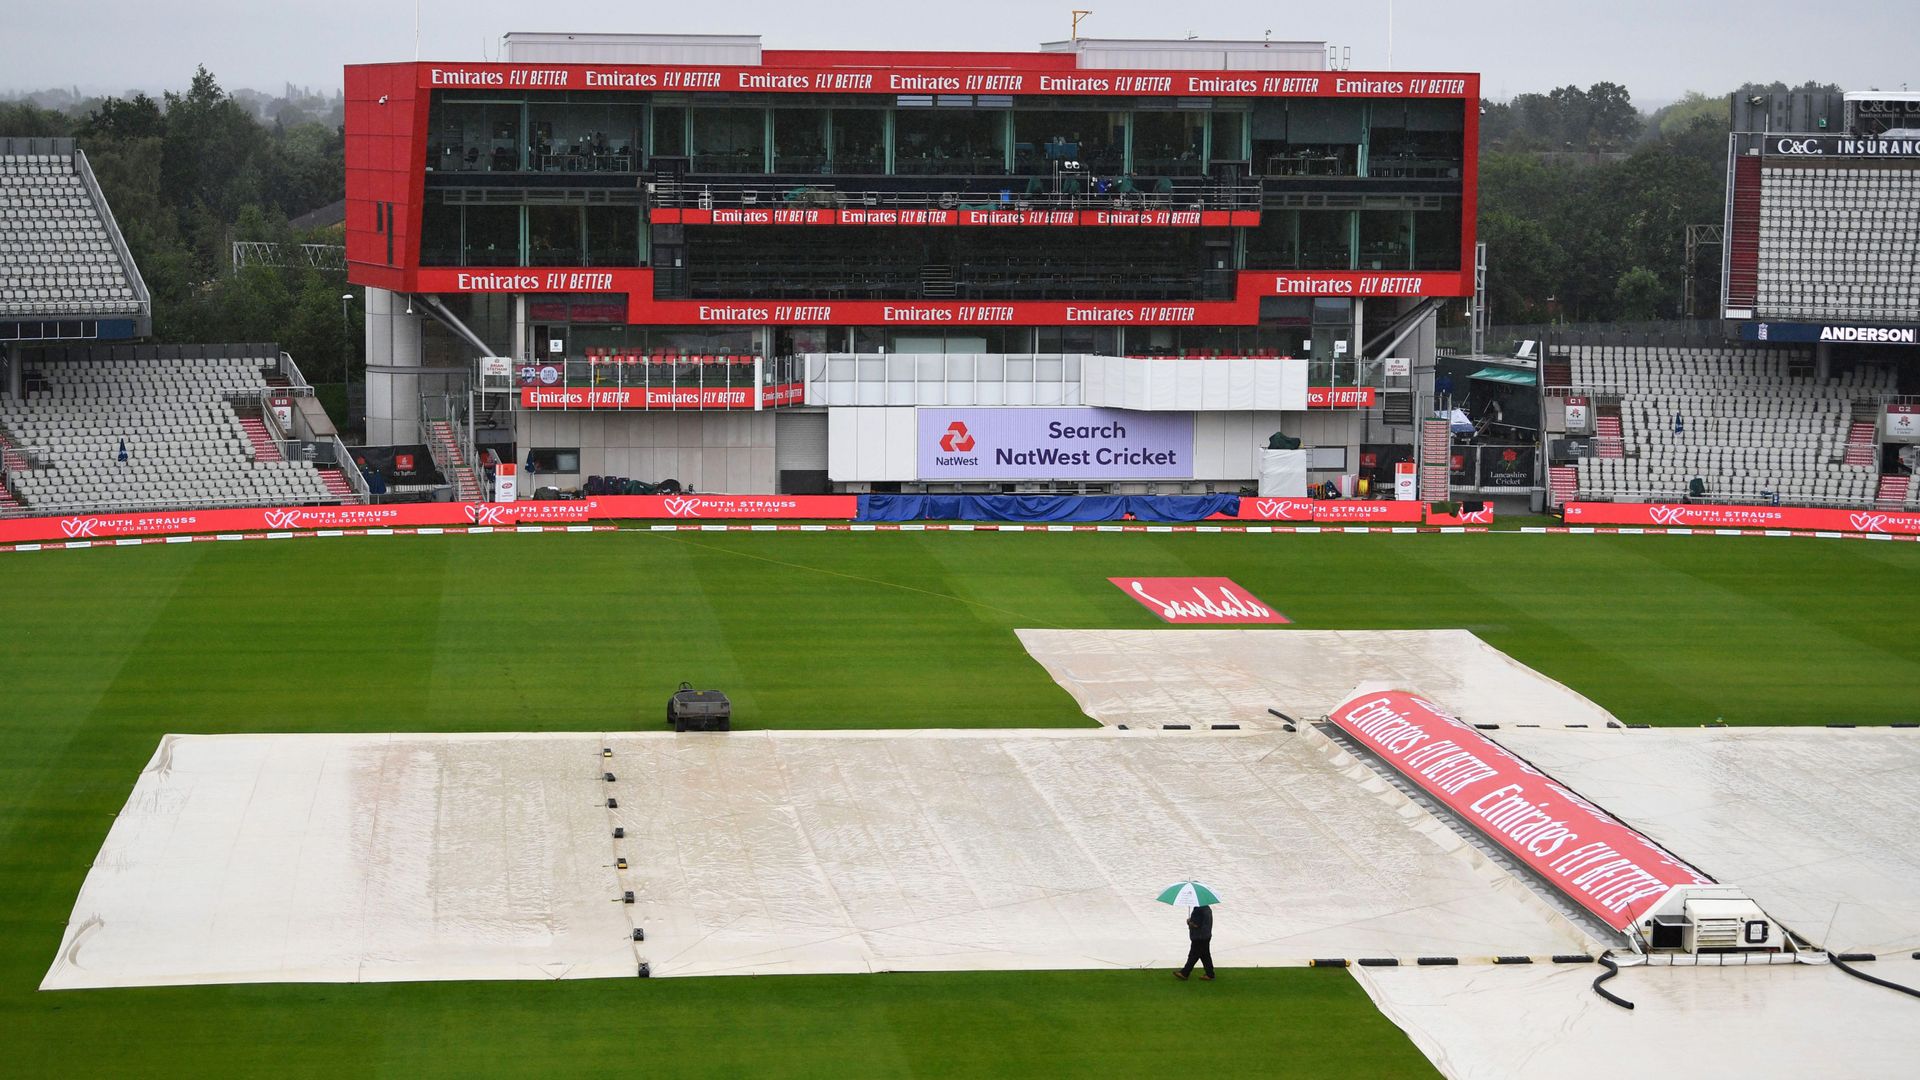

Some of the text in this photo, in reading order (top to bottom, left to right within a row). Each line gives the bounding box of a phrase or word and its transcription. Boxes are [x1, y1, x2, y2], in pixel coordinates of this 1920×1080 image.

[431, 69, 568, 86] Emirates FLY BETTER
[585, 71, 721, 87] Emirates FLY BETTER
[738, 72, 873, 89] Emirates FLY BETTER
[889, 74, 1023, 91] Emirates FLY BETTER
[1039, 76, 1172, 92] Emirates FLY BETTER
[1188, 77, 1319, 93] Emirates FLY BETTER
[1335, 79, 1465, 94] Emirates FLY BETTER
[1778, 138, 1823, 154] C&C.
[713, 210, 768, 222] Emirates
[774, 211, 788, 221] FLY
[842, 210, 947, 223] Emirates FLY BETTER
[971, 211, 1025, 223] Emirates
[1029, 212, 1044, 223] FLY
[1098, 211, 1201, 224] Emirates FLY BETTER
[457, 273, 613, 290] Emirates FLY BETTER
[1276, 276, 1422, 294] Emirates FLY BETTER
[699, 305, 831, 321] Emirates FLY BETTER
[883, 306, 1014, 321] Emirates FLY BETTER
[1066, 306, 1195, 321] Emirates FLY BETTER
[1820, 327, 1914, 342] ANDERSON
[530, 391, 630, 404] Emirates FLY BETTER
[648, 392, 745, 404] Emirates FLY BETTER
[1341, 392, 1368, 403] BETTER
[1049, 421, 1126, 439] Search
[936, 456, 979, 466] NatWest
[995, 448, 1177, 465] NatWest Cricket
[1490, 471, 1528, 479] Lancashire
[100, 516, 197, 527] RUTH STRAUSS
[302, 510, 398, 519] RUTH STRAUSS
[1725, 511, 1782, 519] STRAUSS
[1131, 581, 1270, 619] Sandals
[1345, 698, 1430, 754] Emirates
[1403, 740, 1464, 769] FLY
[1420, 752, 1499, 796] BETTER
[1470, 783, 1578, 858] Emirates
[1549, 841, 1620, 877] FLY
[1572, 858, 1670, 913] BETTER
